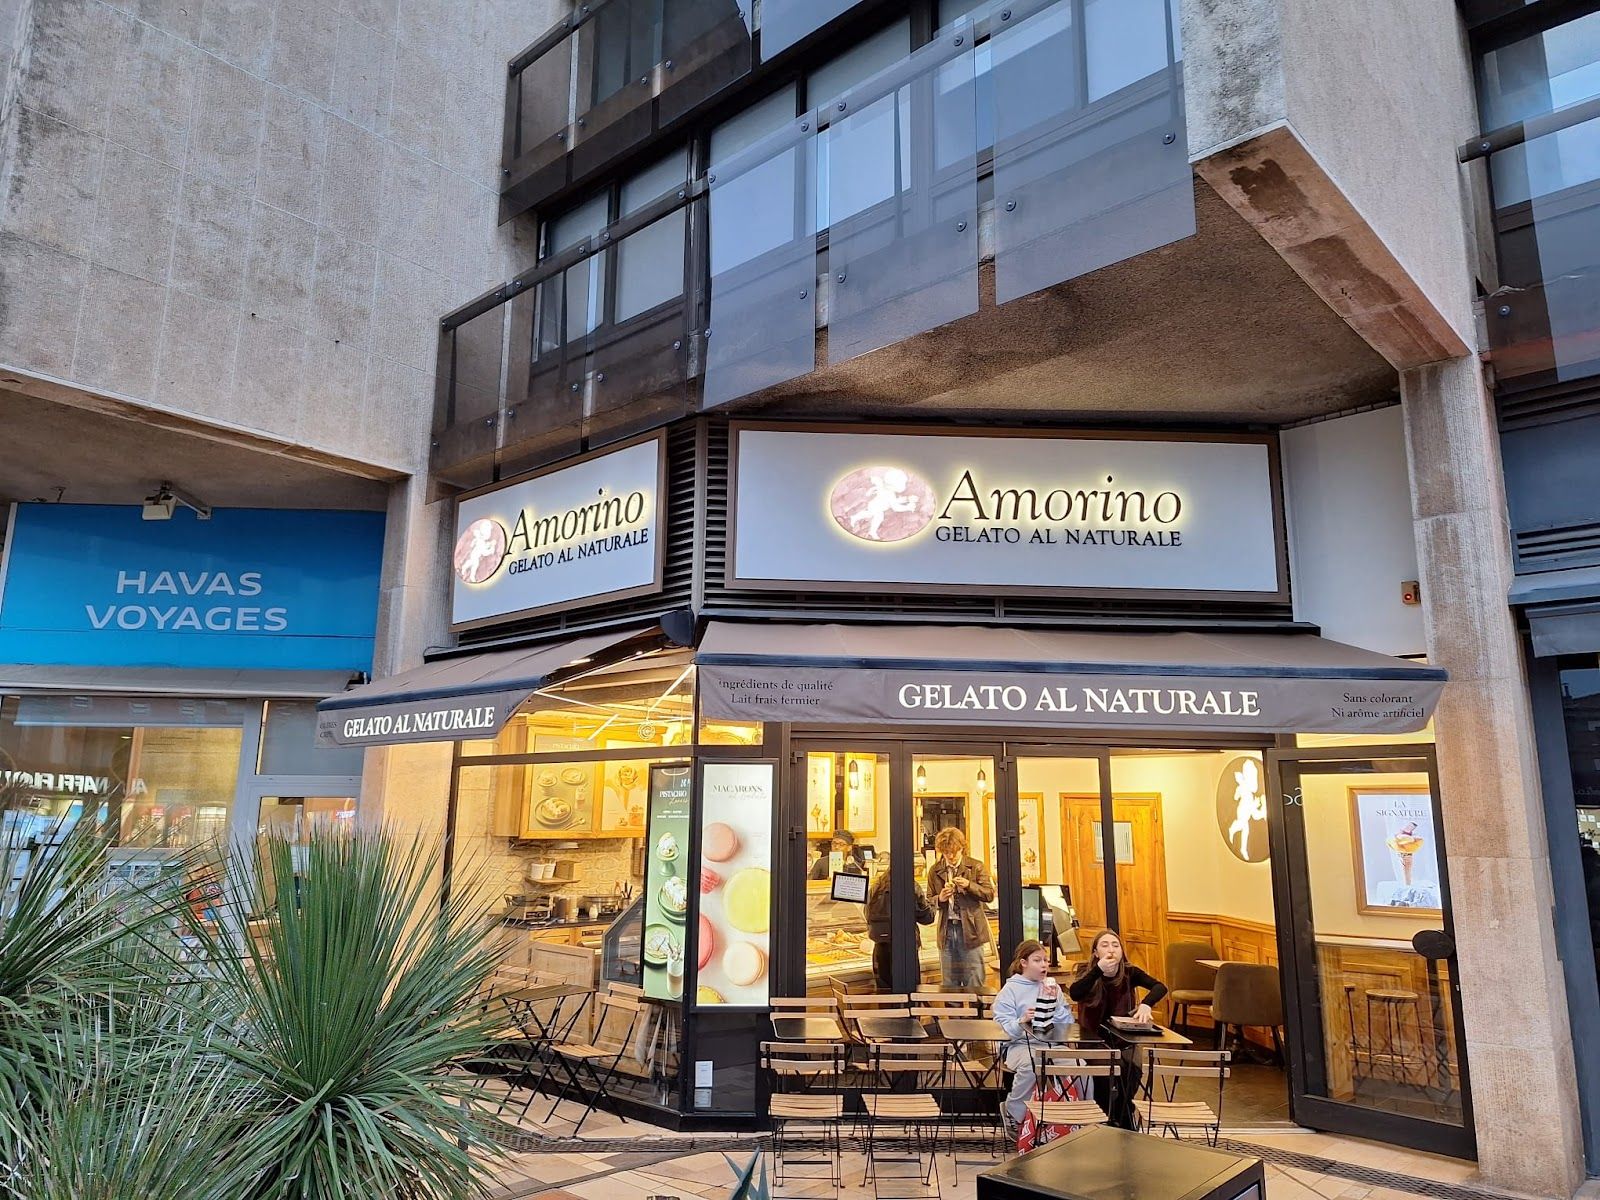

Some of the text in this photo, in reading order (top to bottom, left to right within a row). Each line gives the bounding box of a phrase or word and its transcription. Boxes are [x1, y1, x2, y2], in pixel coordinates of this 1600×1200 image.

[938, 469, 1182, 523] Amorino
[506, 487, 644, 556] Amorino
[935, 525, 1182, 547] GELATO AL NATURALE
[508, 527, 649, 575] GELATO AL NATURALE
[116, 570, 262, 596] HAVAS
[85, 604, 287, 631] VOYAGES
[781, 680, 795, 690] de
[797, 679, 834, 692] qualité
[731, 693, 820, 705] Lait frais fermier
[898, 683, 1262, 716] GELATO AL NATURALE
[1343, 692, 1412, 704] Sans colorant
[343, 706, 495, 738] GELATO AL NATURALE
[1331, 706, 1424, 718] Ni arôme artificiel
[712, 784, 763, 793] MACARONS
[1376, 809, 1428, 817] SIGNATURE
[1394, 800, 1406, 808] LA
